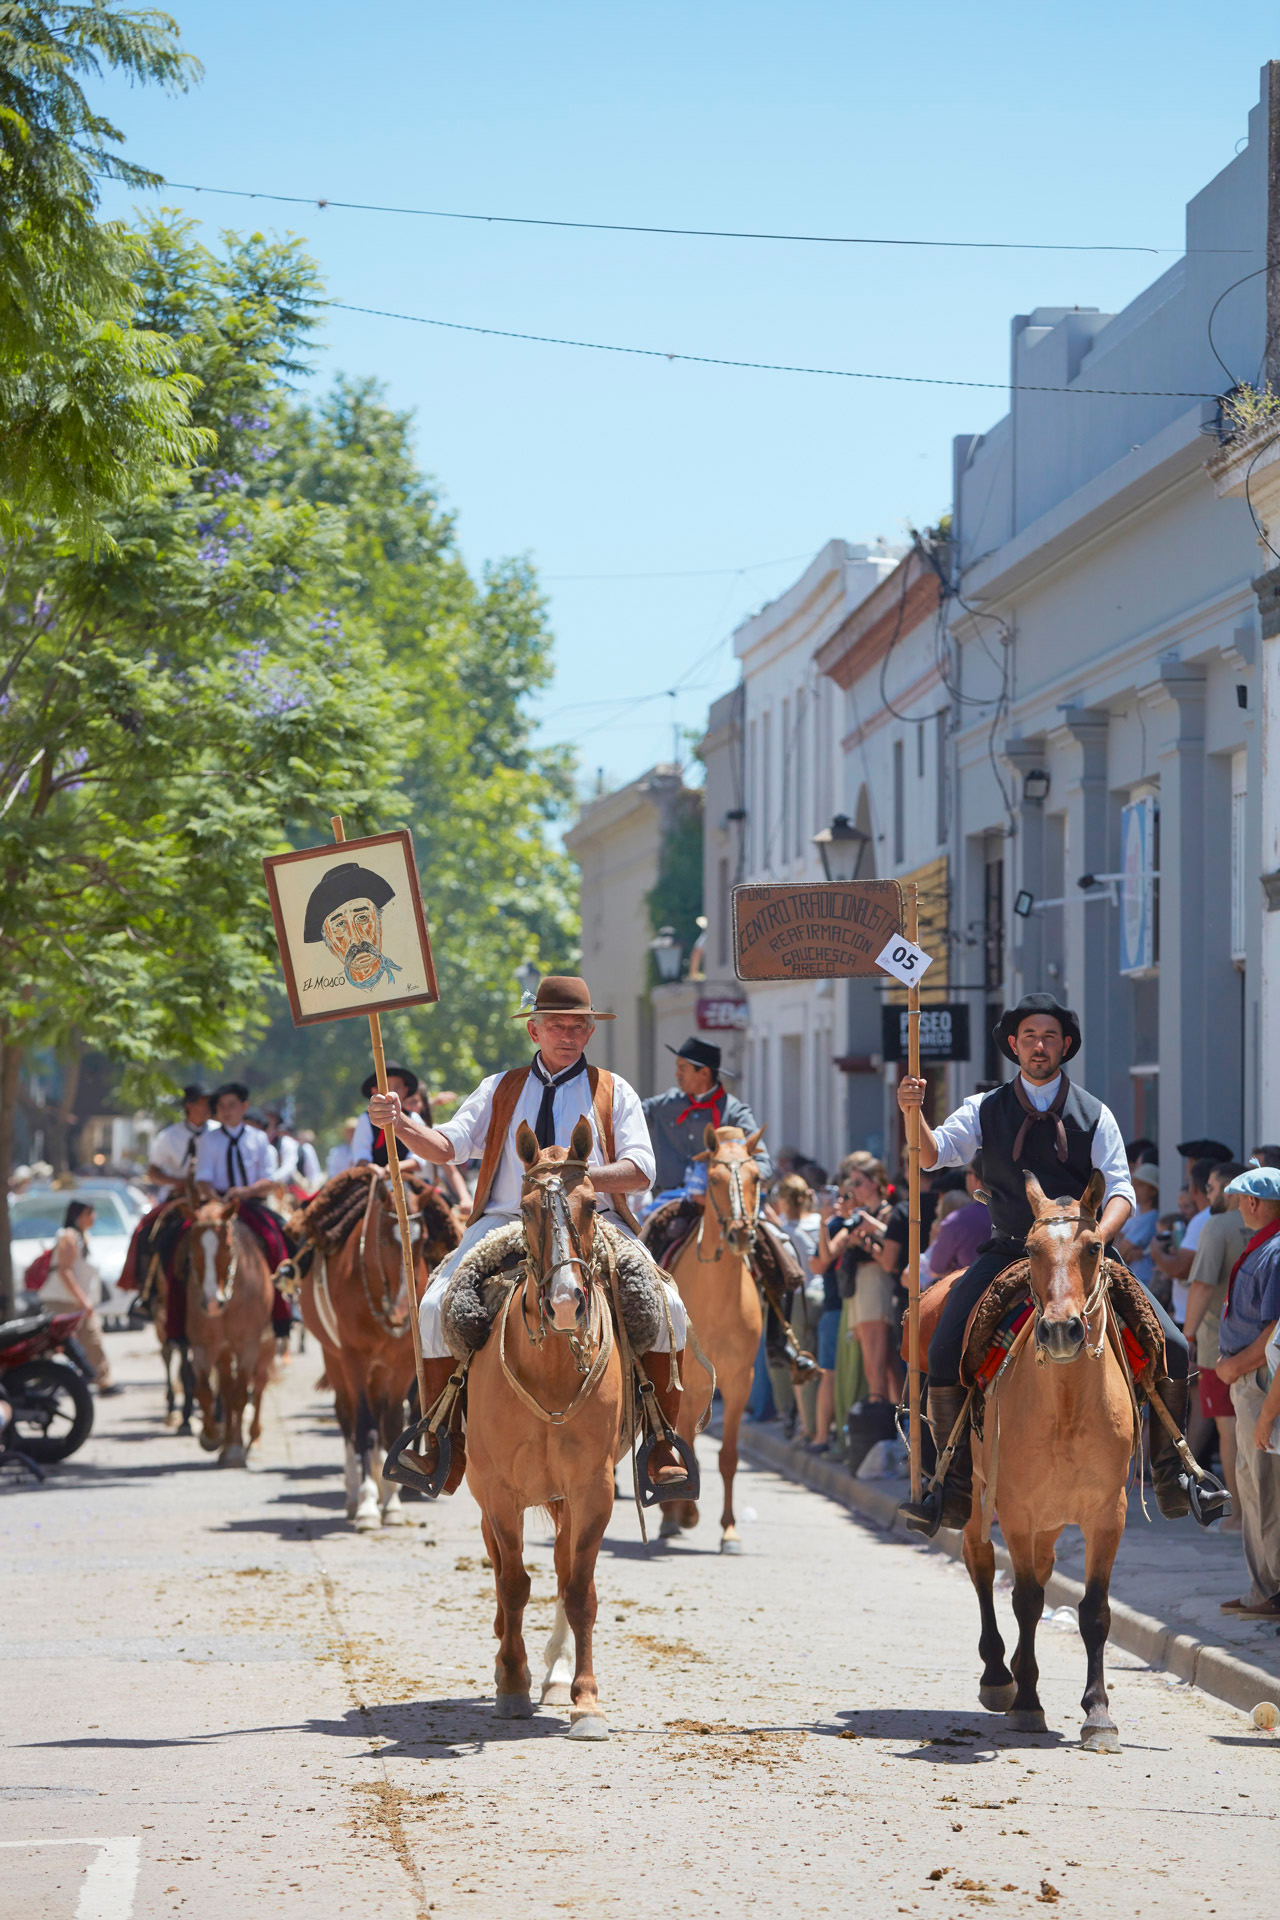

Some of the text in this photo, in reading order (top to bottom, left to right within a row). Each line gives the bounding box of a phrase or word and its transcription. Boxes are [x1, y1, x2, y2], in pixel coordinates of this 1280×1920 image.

[739, 892, 900, 955] CENTRO TRADICIONALISTA
[769, 923, 873, 954] REAFIRMACIÓN
[782, 947, 857, 967] GAUCHESCA
[892, 946, 919, 970] 05
[792, 962, 835, 974] ARECO
[303, 977, 314, 991] EL
[900, 1011, 952, 1032] PSEO
